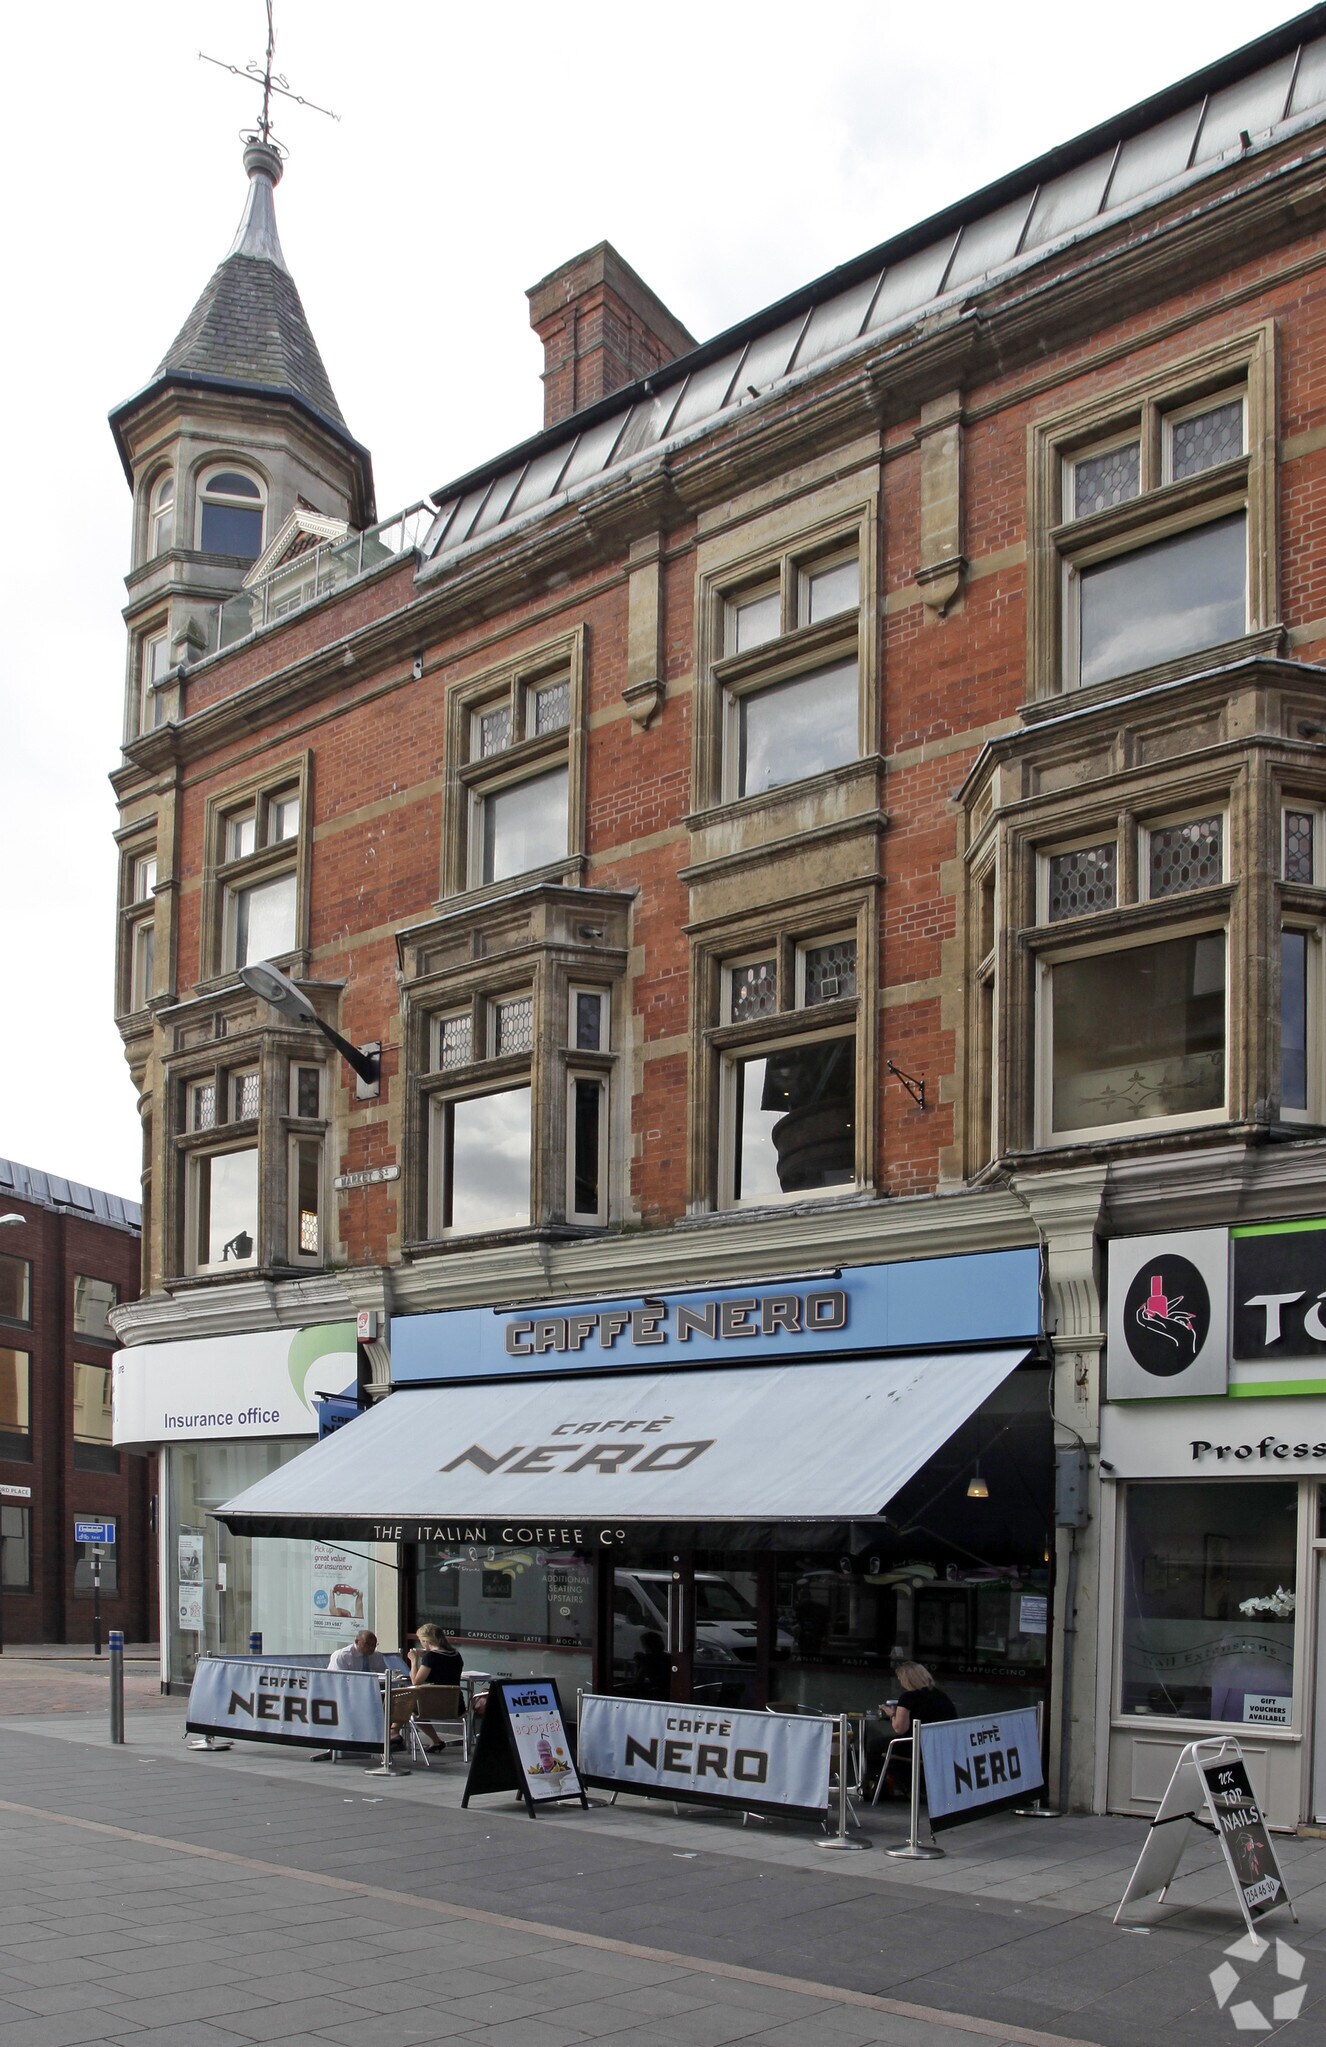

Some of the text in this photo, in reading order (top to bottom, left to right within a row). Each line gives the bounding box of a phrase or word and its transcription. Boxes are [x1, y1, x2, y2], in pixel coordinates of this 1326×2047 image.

[341, 1172, 373, 1186] MARKET
[505, 1290, 848, 1355] CAFFÈ NERO
[164, 1408, 280, 1428] Insurance office
[551, 1416, 675, 1436] CAFFÈ
[438, 1438, 718, 1474] NERO
[374, 1525, 402, 1540] THE
[418, 1526, 486, 1541] ITALIAN
[502, 1528, 583, 1543] COFFEE
[324, 1563, 353, 1571] insurance
[542, 1574, 591, 1584] ADDITIONAL
[548, 1584, 583, 1594] SEATING
[547, 1594, 584, 1604] UPSTAIRS
[467, 1631, 582, 1646] CAPPUCCINO LATTE MOCHA
[958, 1665, 1026, 1677] CAPPUCCINO
[259, 1675, 308, 1690] CAFFÈ
[227, 1690, 339, 1727] NERO
[511, 1695, 549, 1707] NERO
[1249, 1705, 1286, 1714] VOUCHERS
[1249, 1713, 1286, 1722] AVAILABLE
[515, 1719, 560, 1736] BOOSTER
[666, 1718, 731, 1737] CAFFÈ
[969, 1723, 1001, 1747] CAFFÈ
[625, 1734, 768, 1784] NERO
[953, 1746, 1022, 1795] NERO
[1218, 1770, 1235, 1785] UK
[1220, 1787, 1242, 1806] TOP
[1221, 1805, 1259, 1833] NAILS
[1246, 1880, 1275, 1903] 254 46 30
